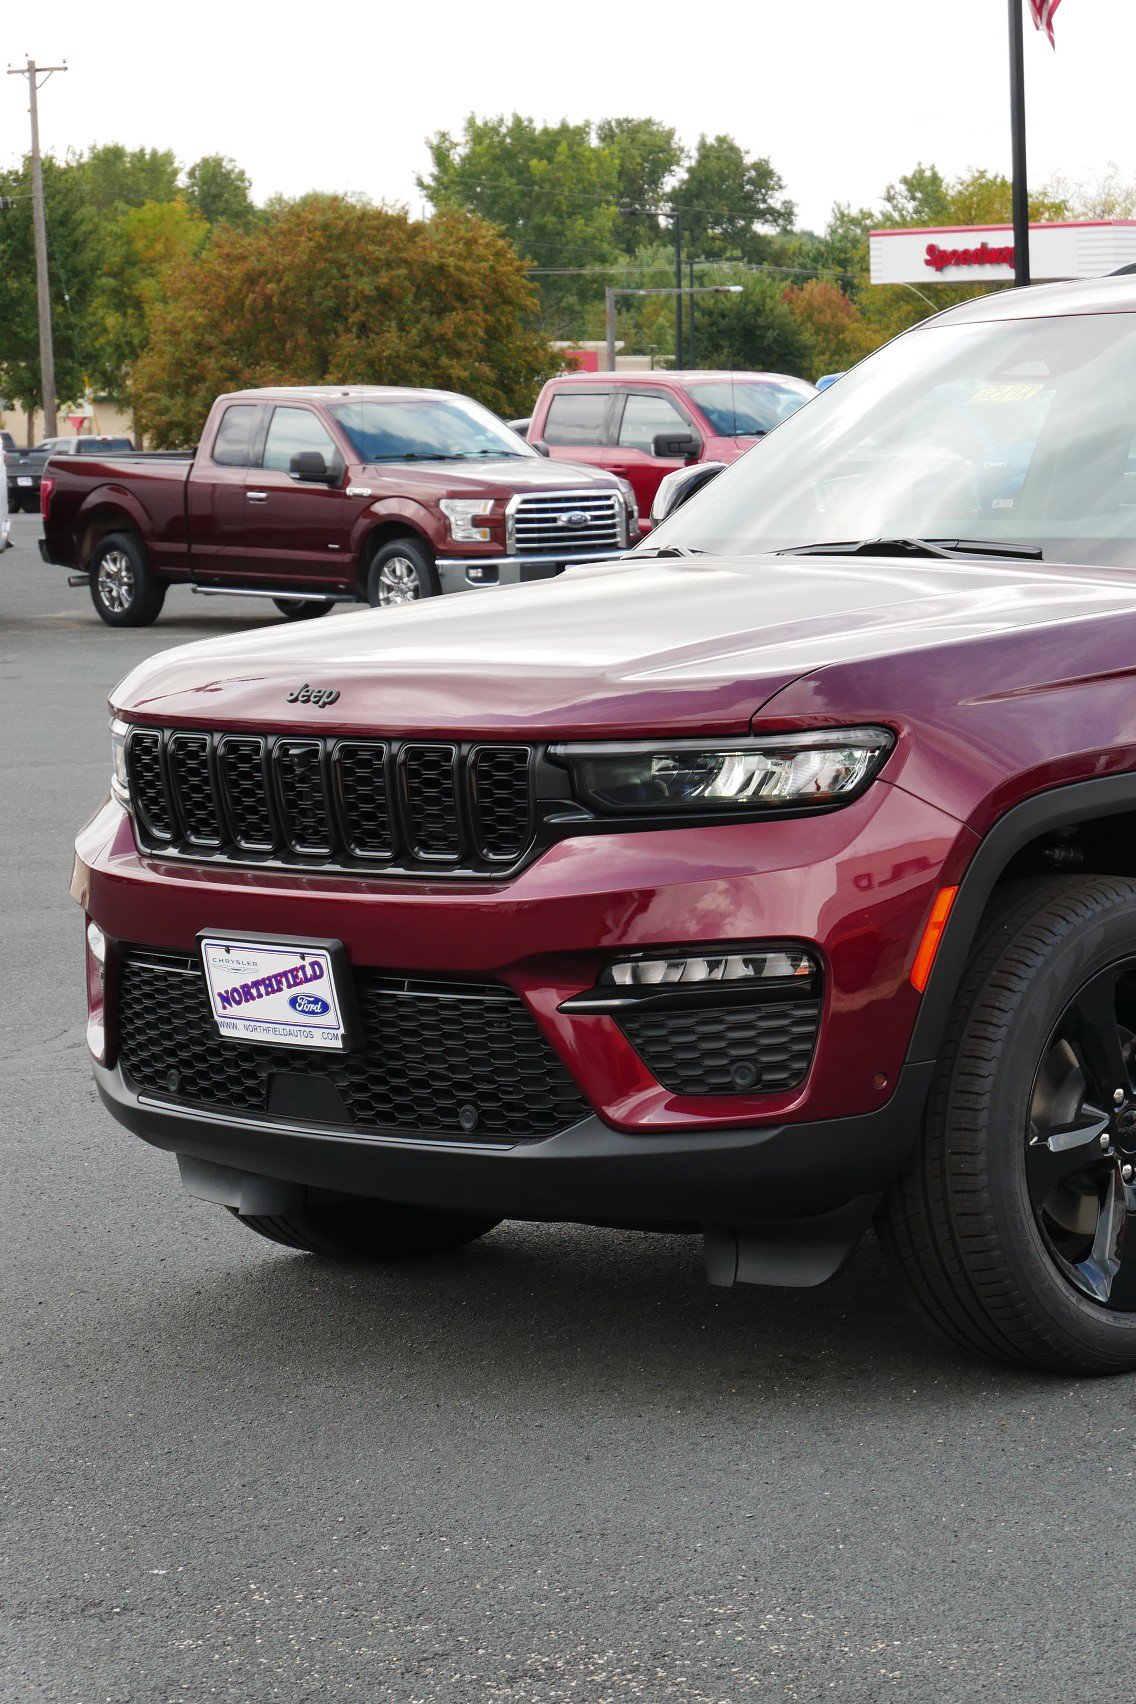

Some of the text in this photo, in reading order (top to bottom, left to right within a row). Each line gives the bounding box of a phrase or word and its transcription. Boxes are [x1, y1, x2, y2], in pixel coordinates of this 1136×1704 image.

[286, 683, 340, 709] Jeep
[212, 957, 258, 967] CHRYSLER
[217, 960, 325, 1010] NORTHFIELD
[296, 996, 323, 1013] Ford
